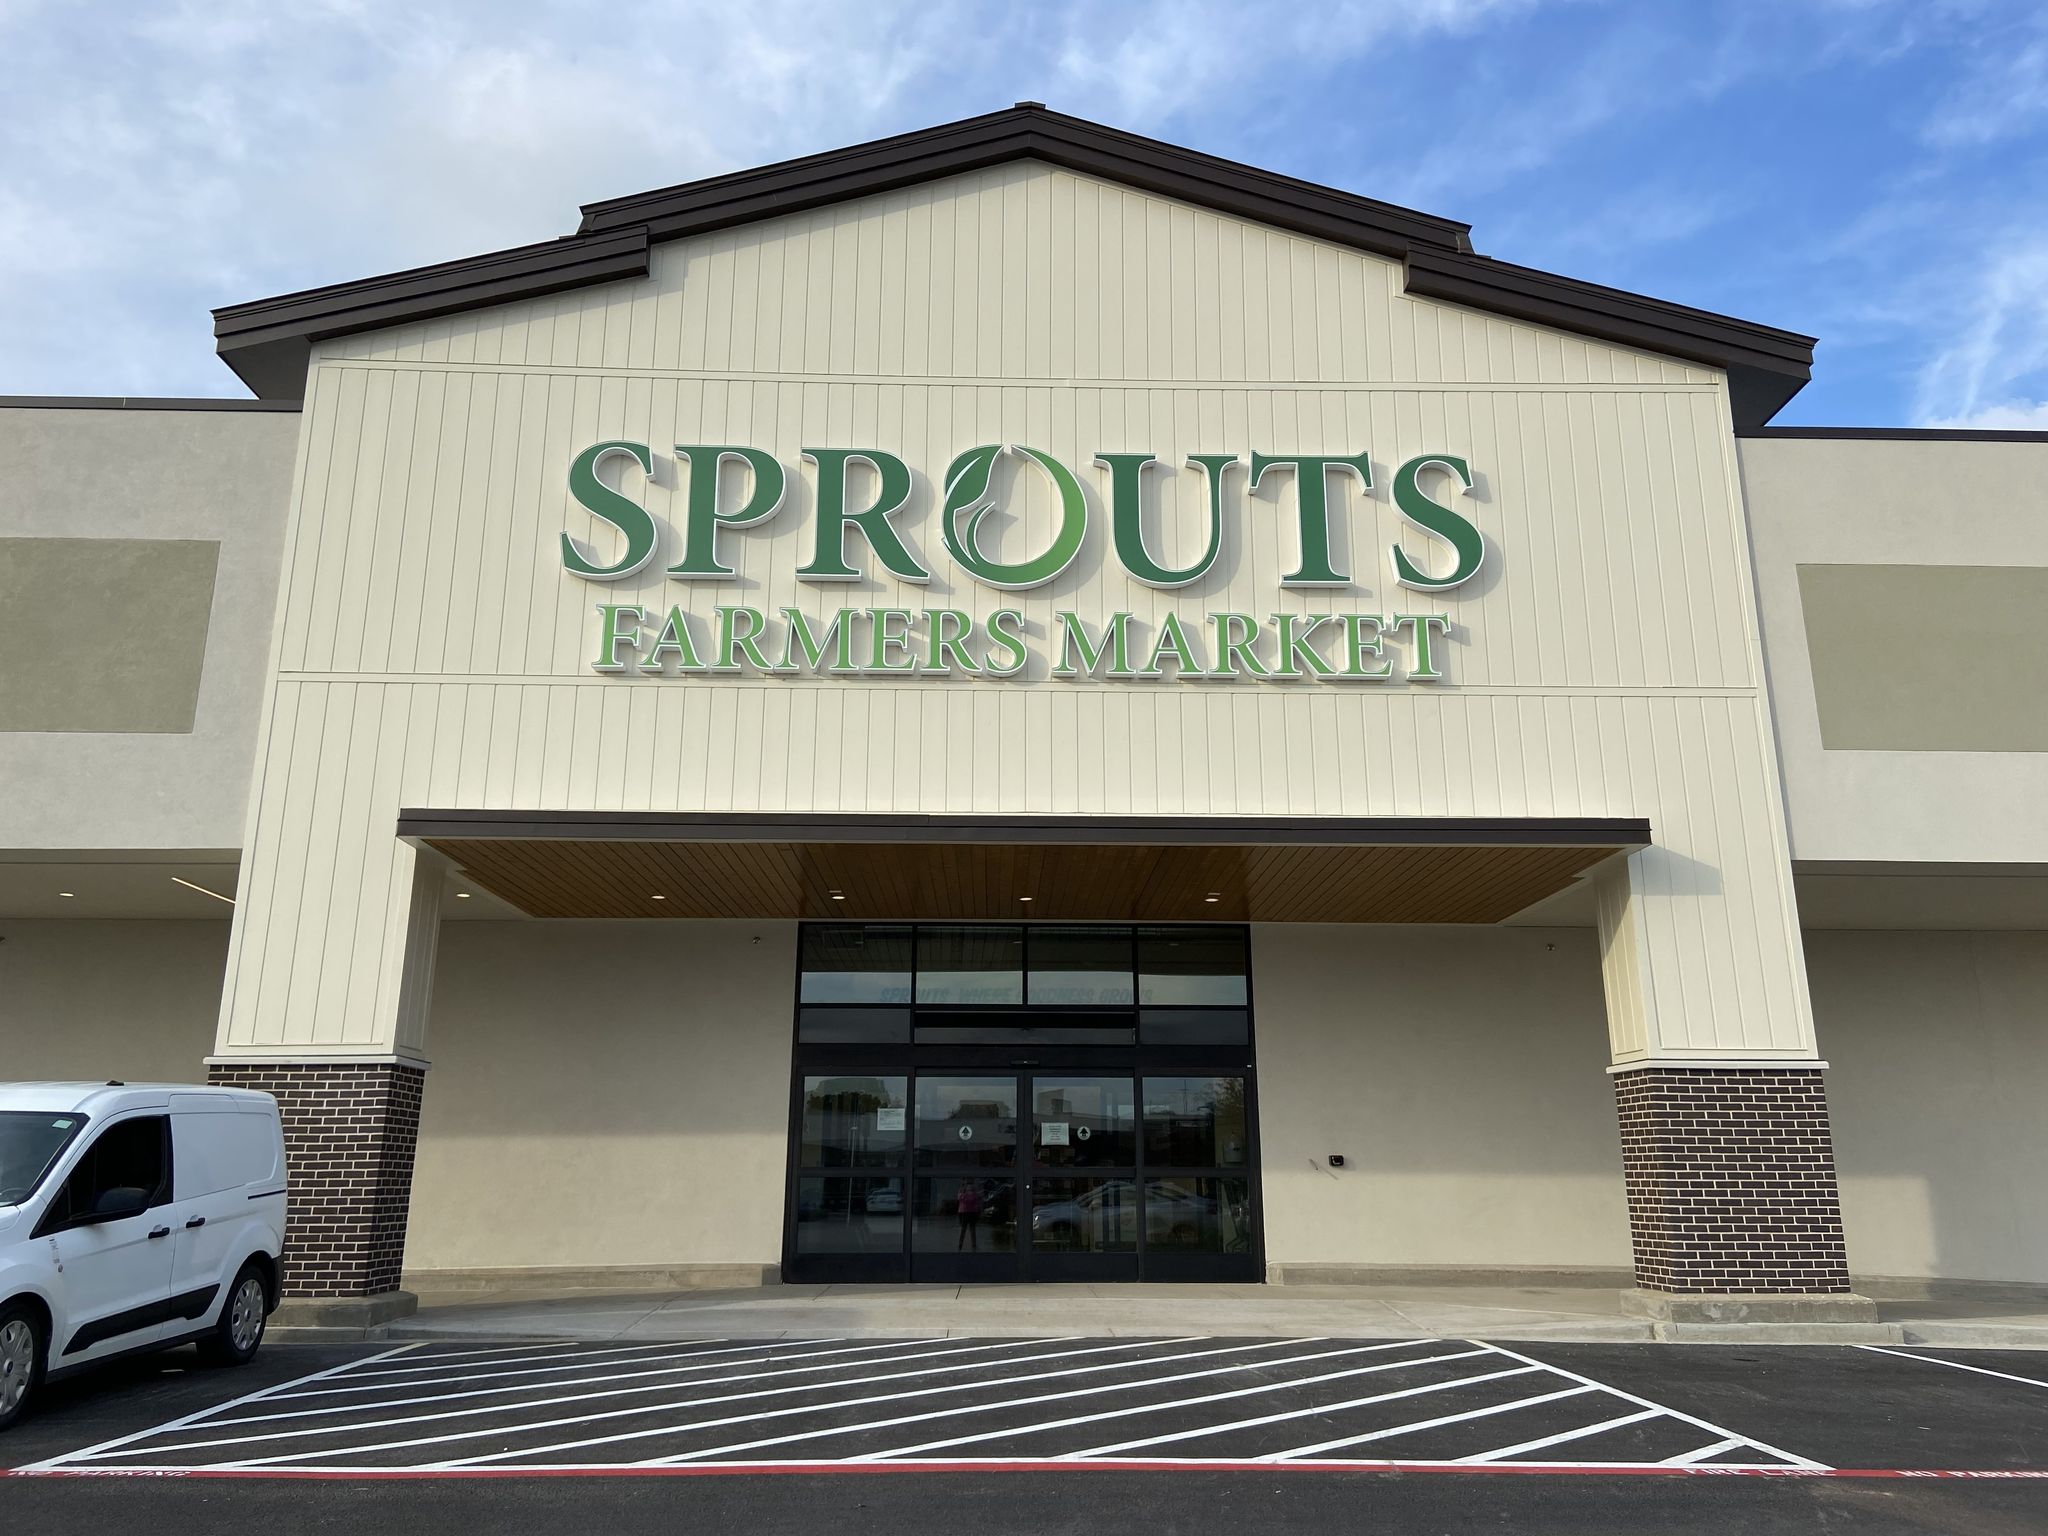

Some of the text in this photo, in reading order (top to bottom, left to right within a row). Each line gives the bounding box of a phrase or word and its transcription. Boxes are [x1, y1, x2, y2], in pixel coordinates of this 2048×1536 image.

[560, 440, 1486, 592] SPROUTS
[592, 604, 1451, 680] FARMERS MARKET
